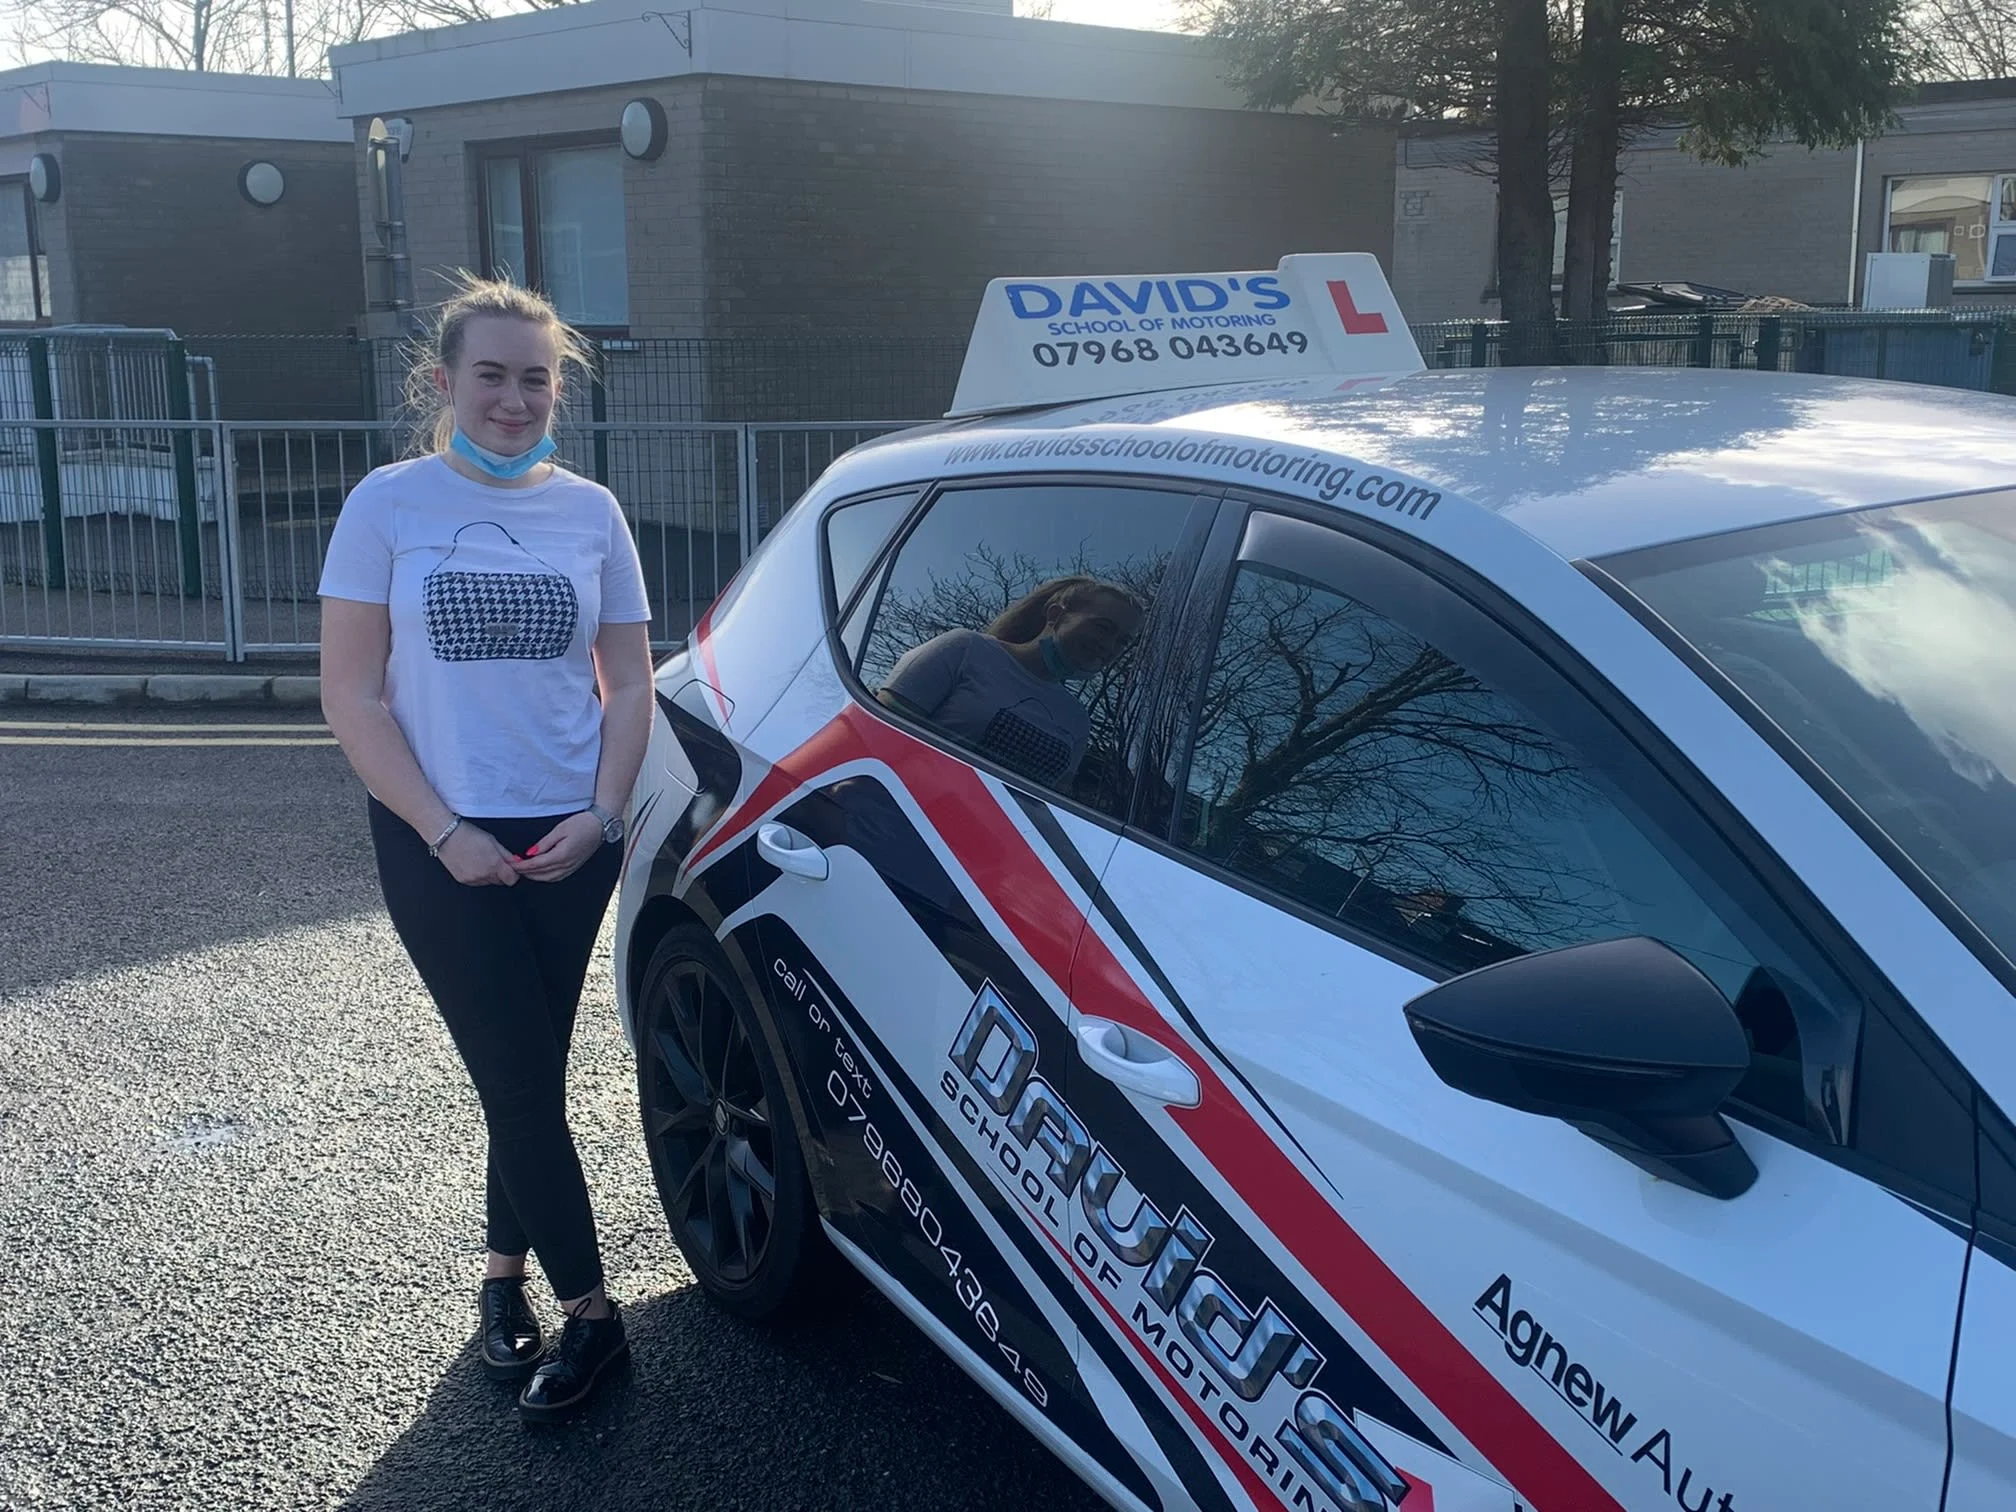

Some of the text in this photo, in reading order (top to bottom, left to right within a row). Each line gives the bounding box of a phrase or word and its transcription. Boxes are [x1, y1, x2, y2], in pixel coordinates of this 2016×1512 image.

[1005, 276, 1291, 319] DAVID'S
[1047, 313, 1277, 336] SCHOOL OF MOTORING
[1326, 280, 1390, 335] L
[1032, 331, 1309, 368] 07968 043649
[943, 433, 1442, 521] www.davidsschoolofmotoring.com
[773, 957, 873, 1099] call or text
[940, 1070, 1061, 1229] SCHOOL
[1073, 1231, 1122, 1291] OF
[826, 1069, 1050, 1408] 07968043649
[1473, 1272, 1639, 1447] Agnew
